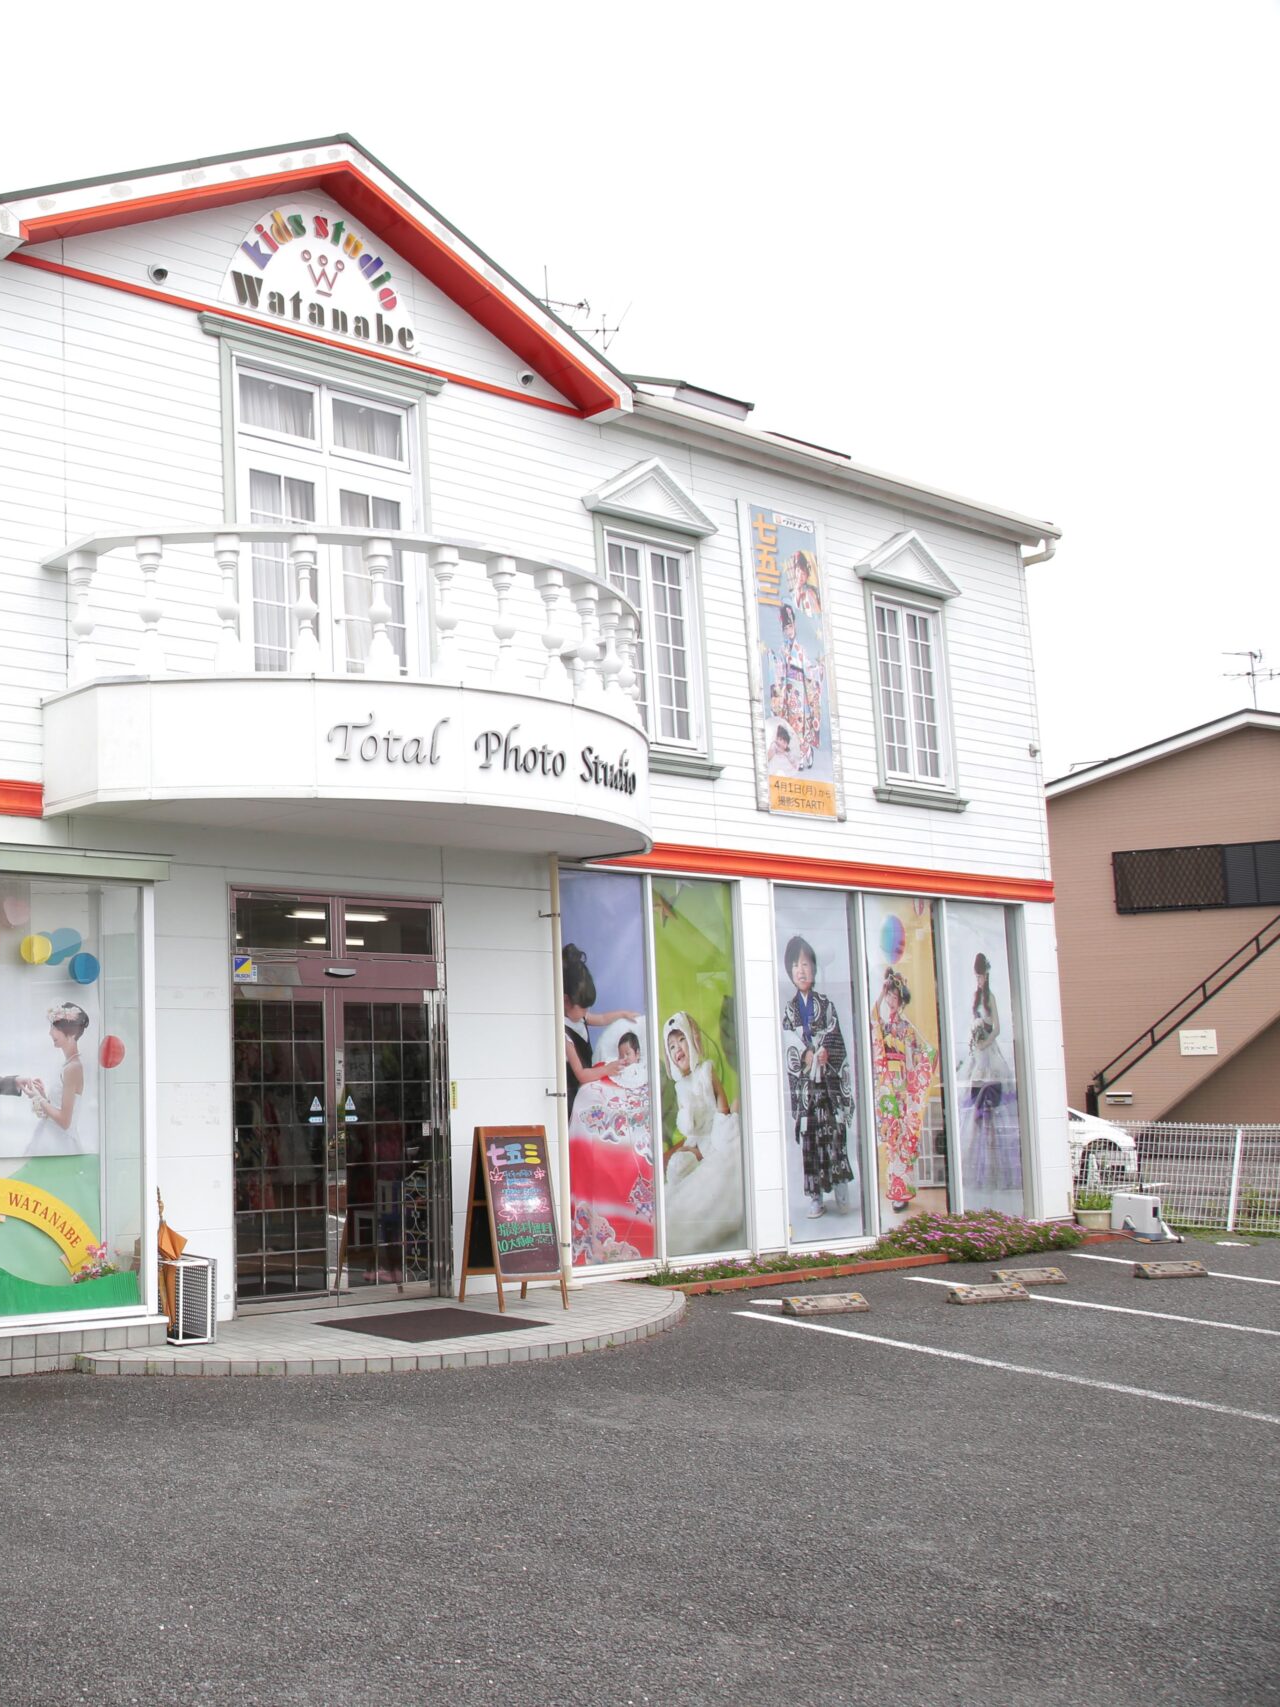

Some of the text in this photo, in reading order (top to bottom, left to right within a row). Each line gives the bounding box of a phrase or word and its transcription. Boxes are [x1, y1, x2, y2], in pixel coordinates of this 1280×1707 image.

[230, 270, 415, 351] Watanabe
[752, 513, 784, 607] 七五三
[327, 711, 637, 796] Total Photo Studio
[487, 1143, 542, 1167] 七五三
[8, 1191, 82, 1249] WATANABE
